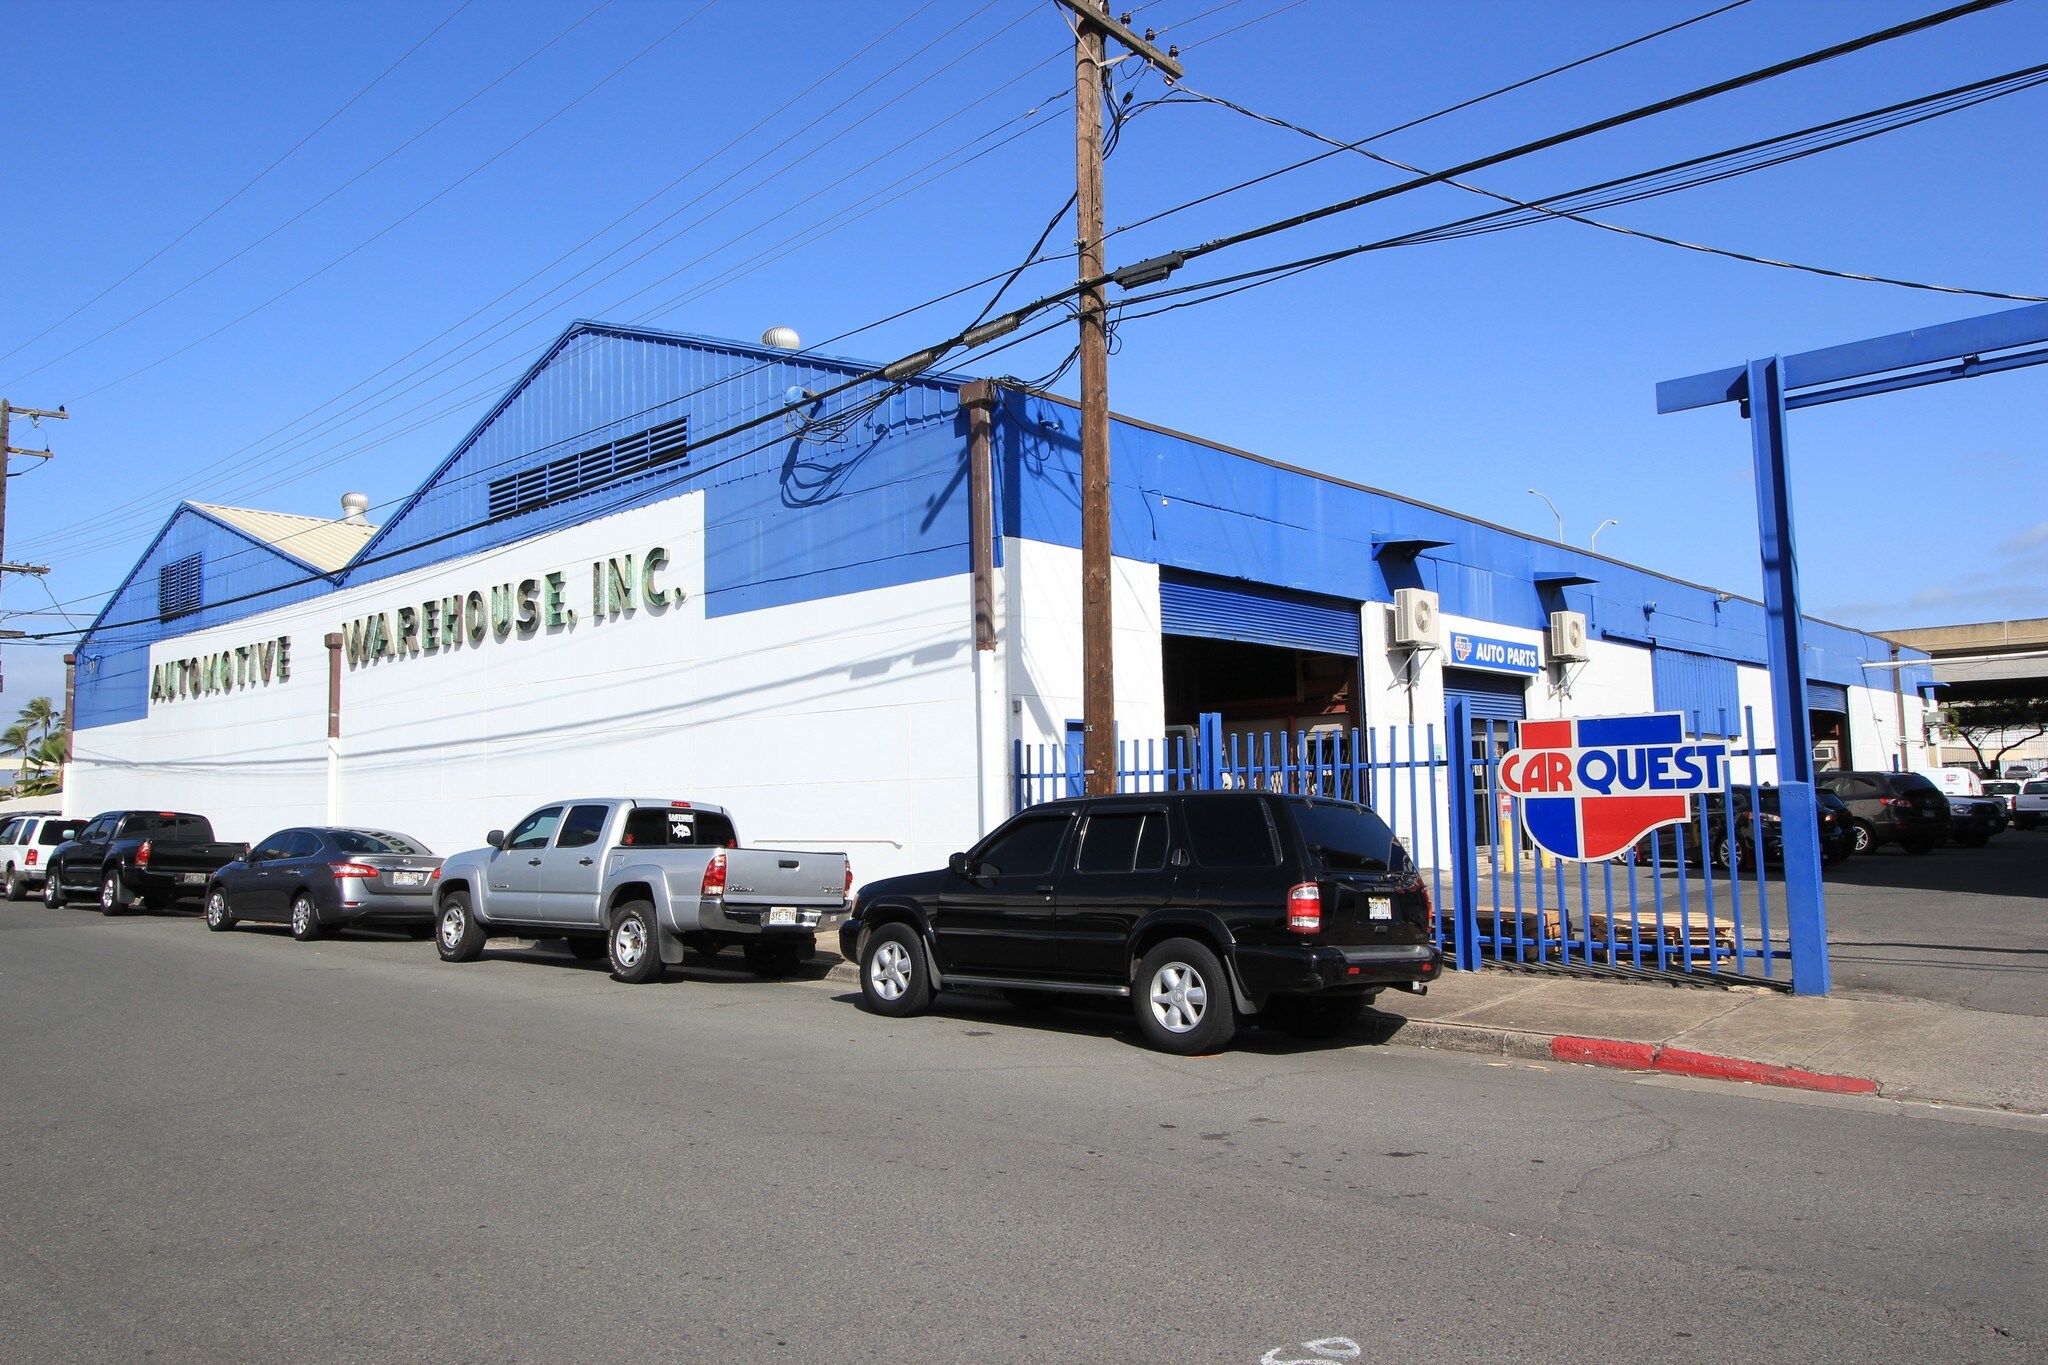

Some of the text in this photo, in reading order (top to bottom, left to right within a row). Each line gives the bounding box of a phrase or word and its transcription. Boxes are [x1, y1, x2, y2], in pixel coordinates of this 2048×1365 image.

[593, 547, 688, 617] INC.
[151, 636, 291, 700] AUTOMOTIVE
[1476, 643, 1536, 668] AUTO PARTS
